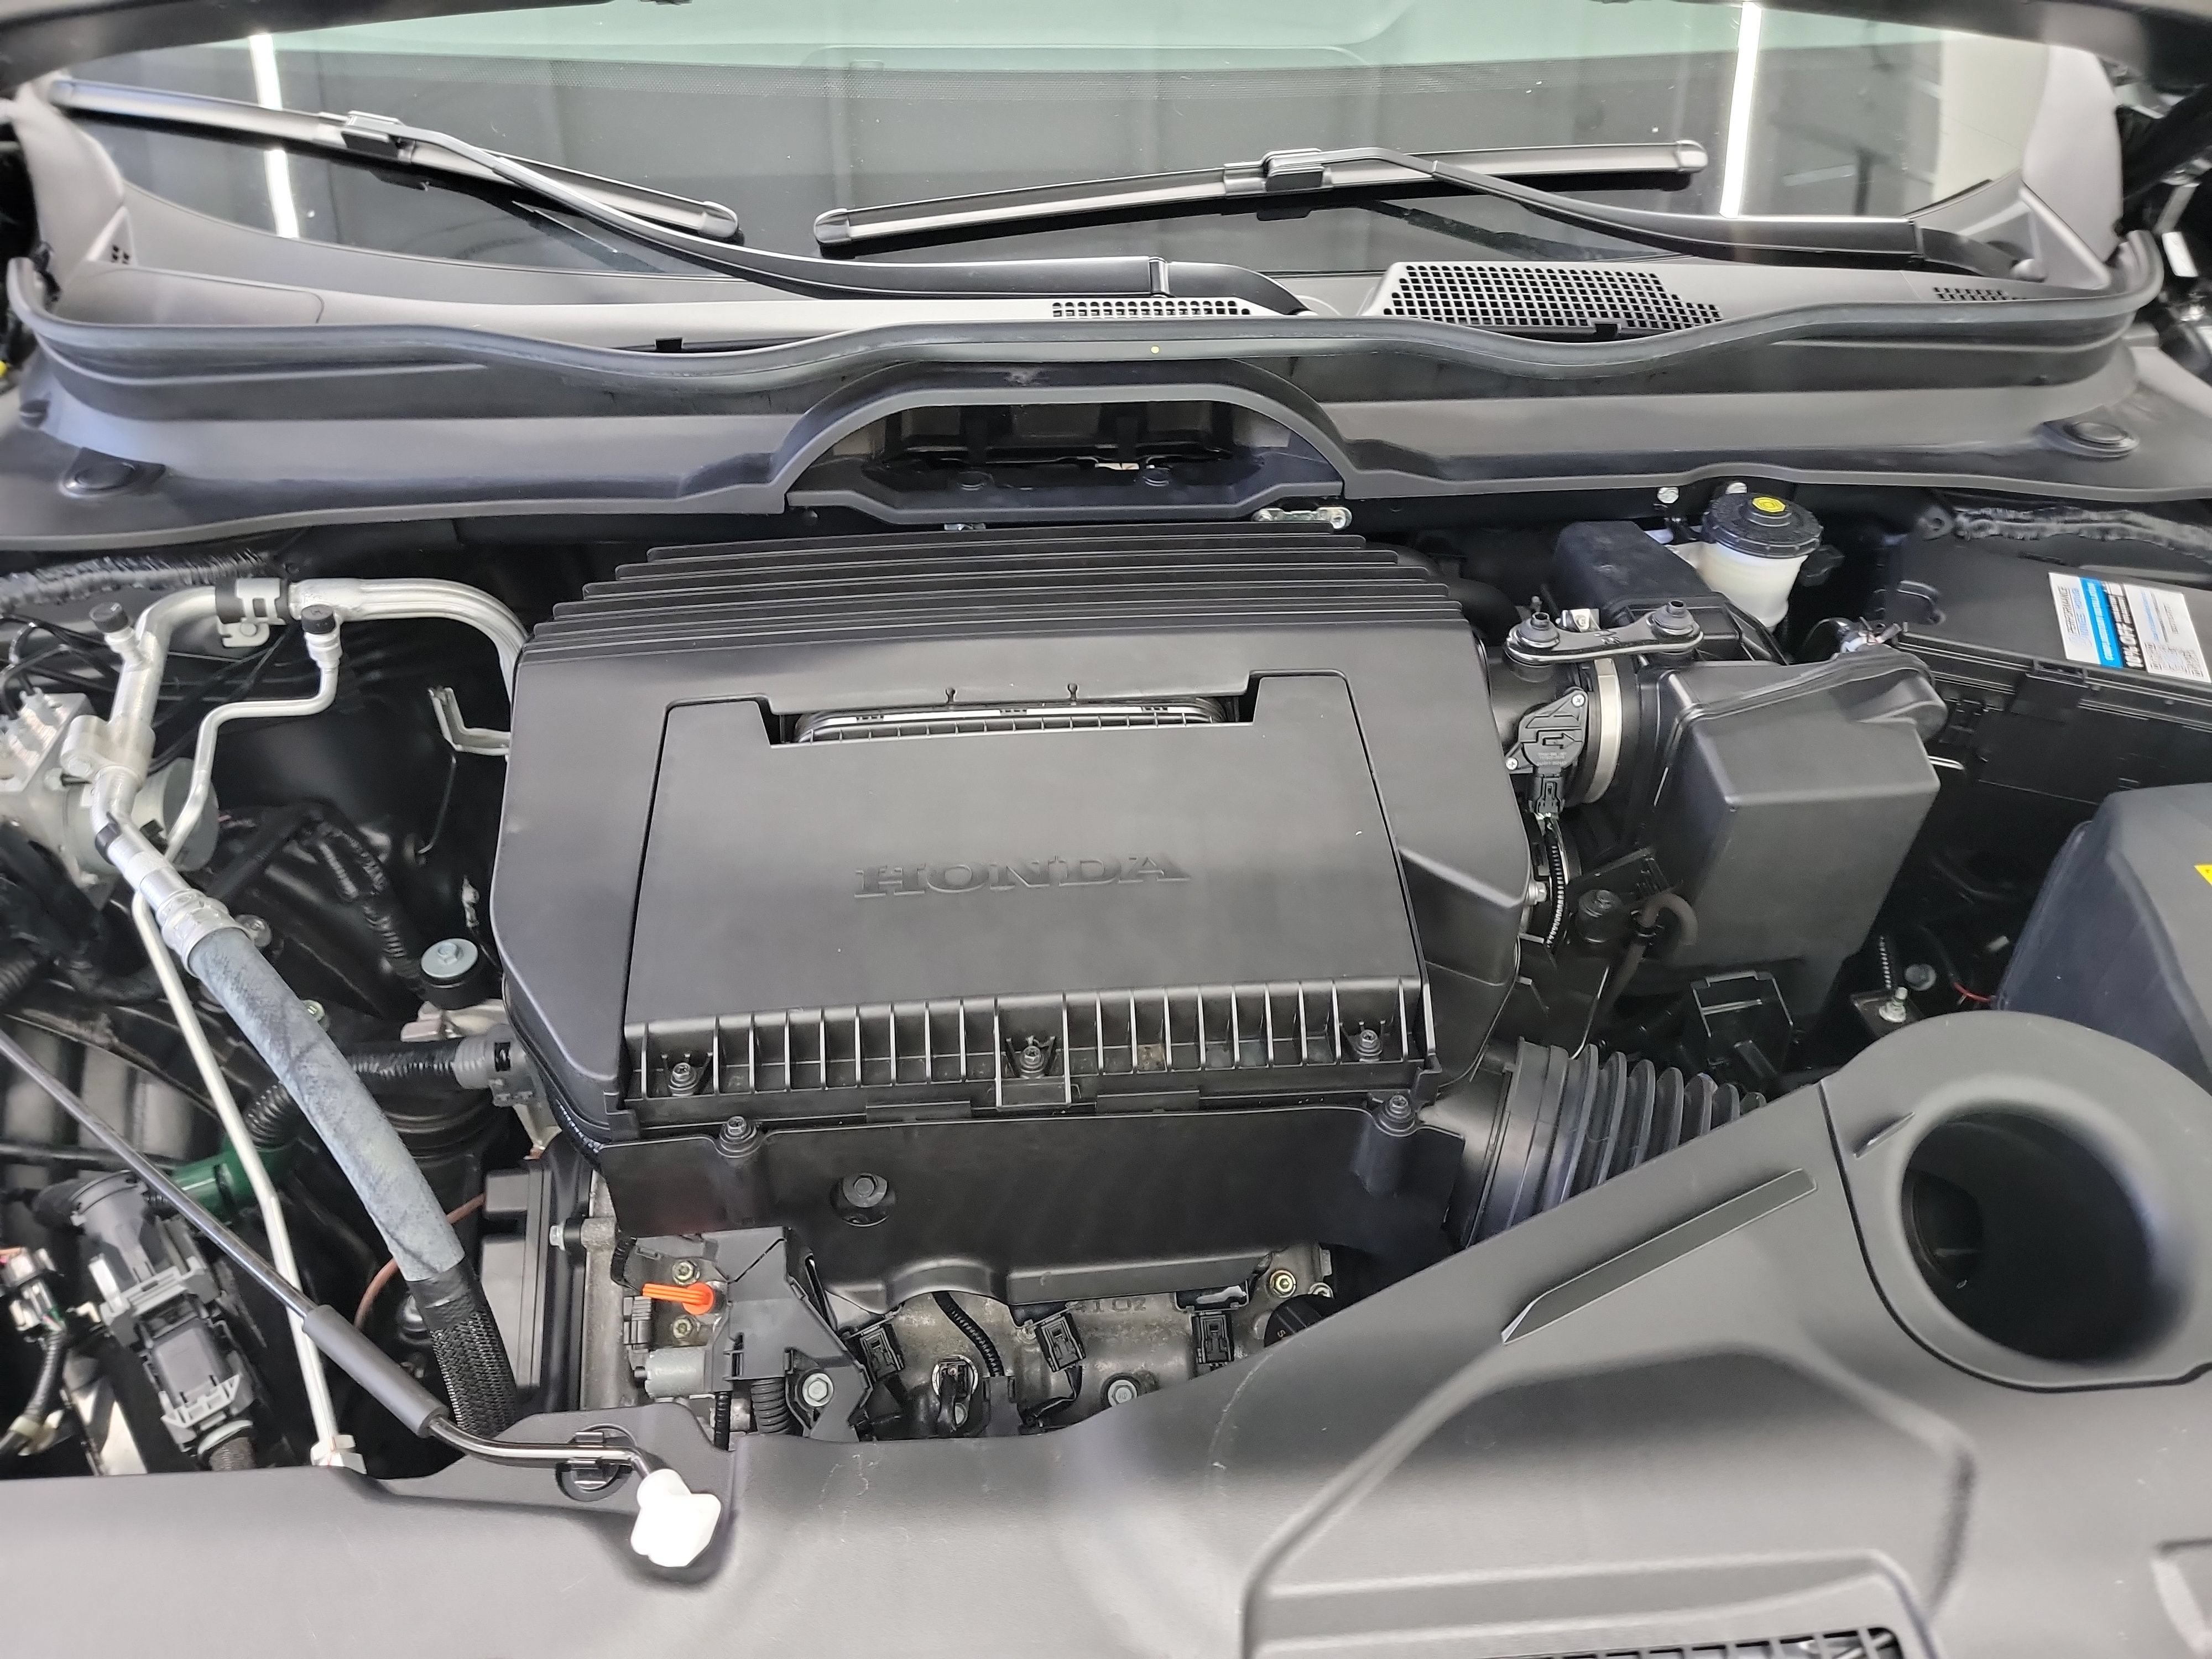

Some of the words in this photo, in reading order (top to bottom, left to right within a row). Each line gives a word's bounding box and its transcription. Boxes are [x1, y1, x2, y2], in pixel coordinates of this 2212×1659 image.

[2058, 586, 2076, 634] PERFORMANCE
[2116, 622, 2136, 645] OFF
[2122, 646, 2143, 667] 10%
[854, 855, 1191, 898] HONDA
